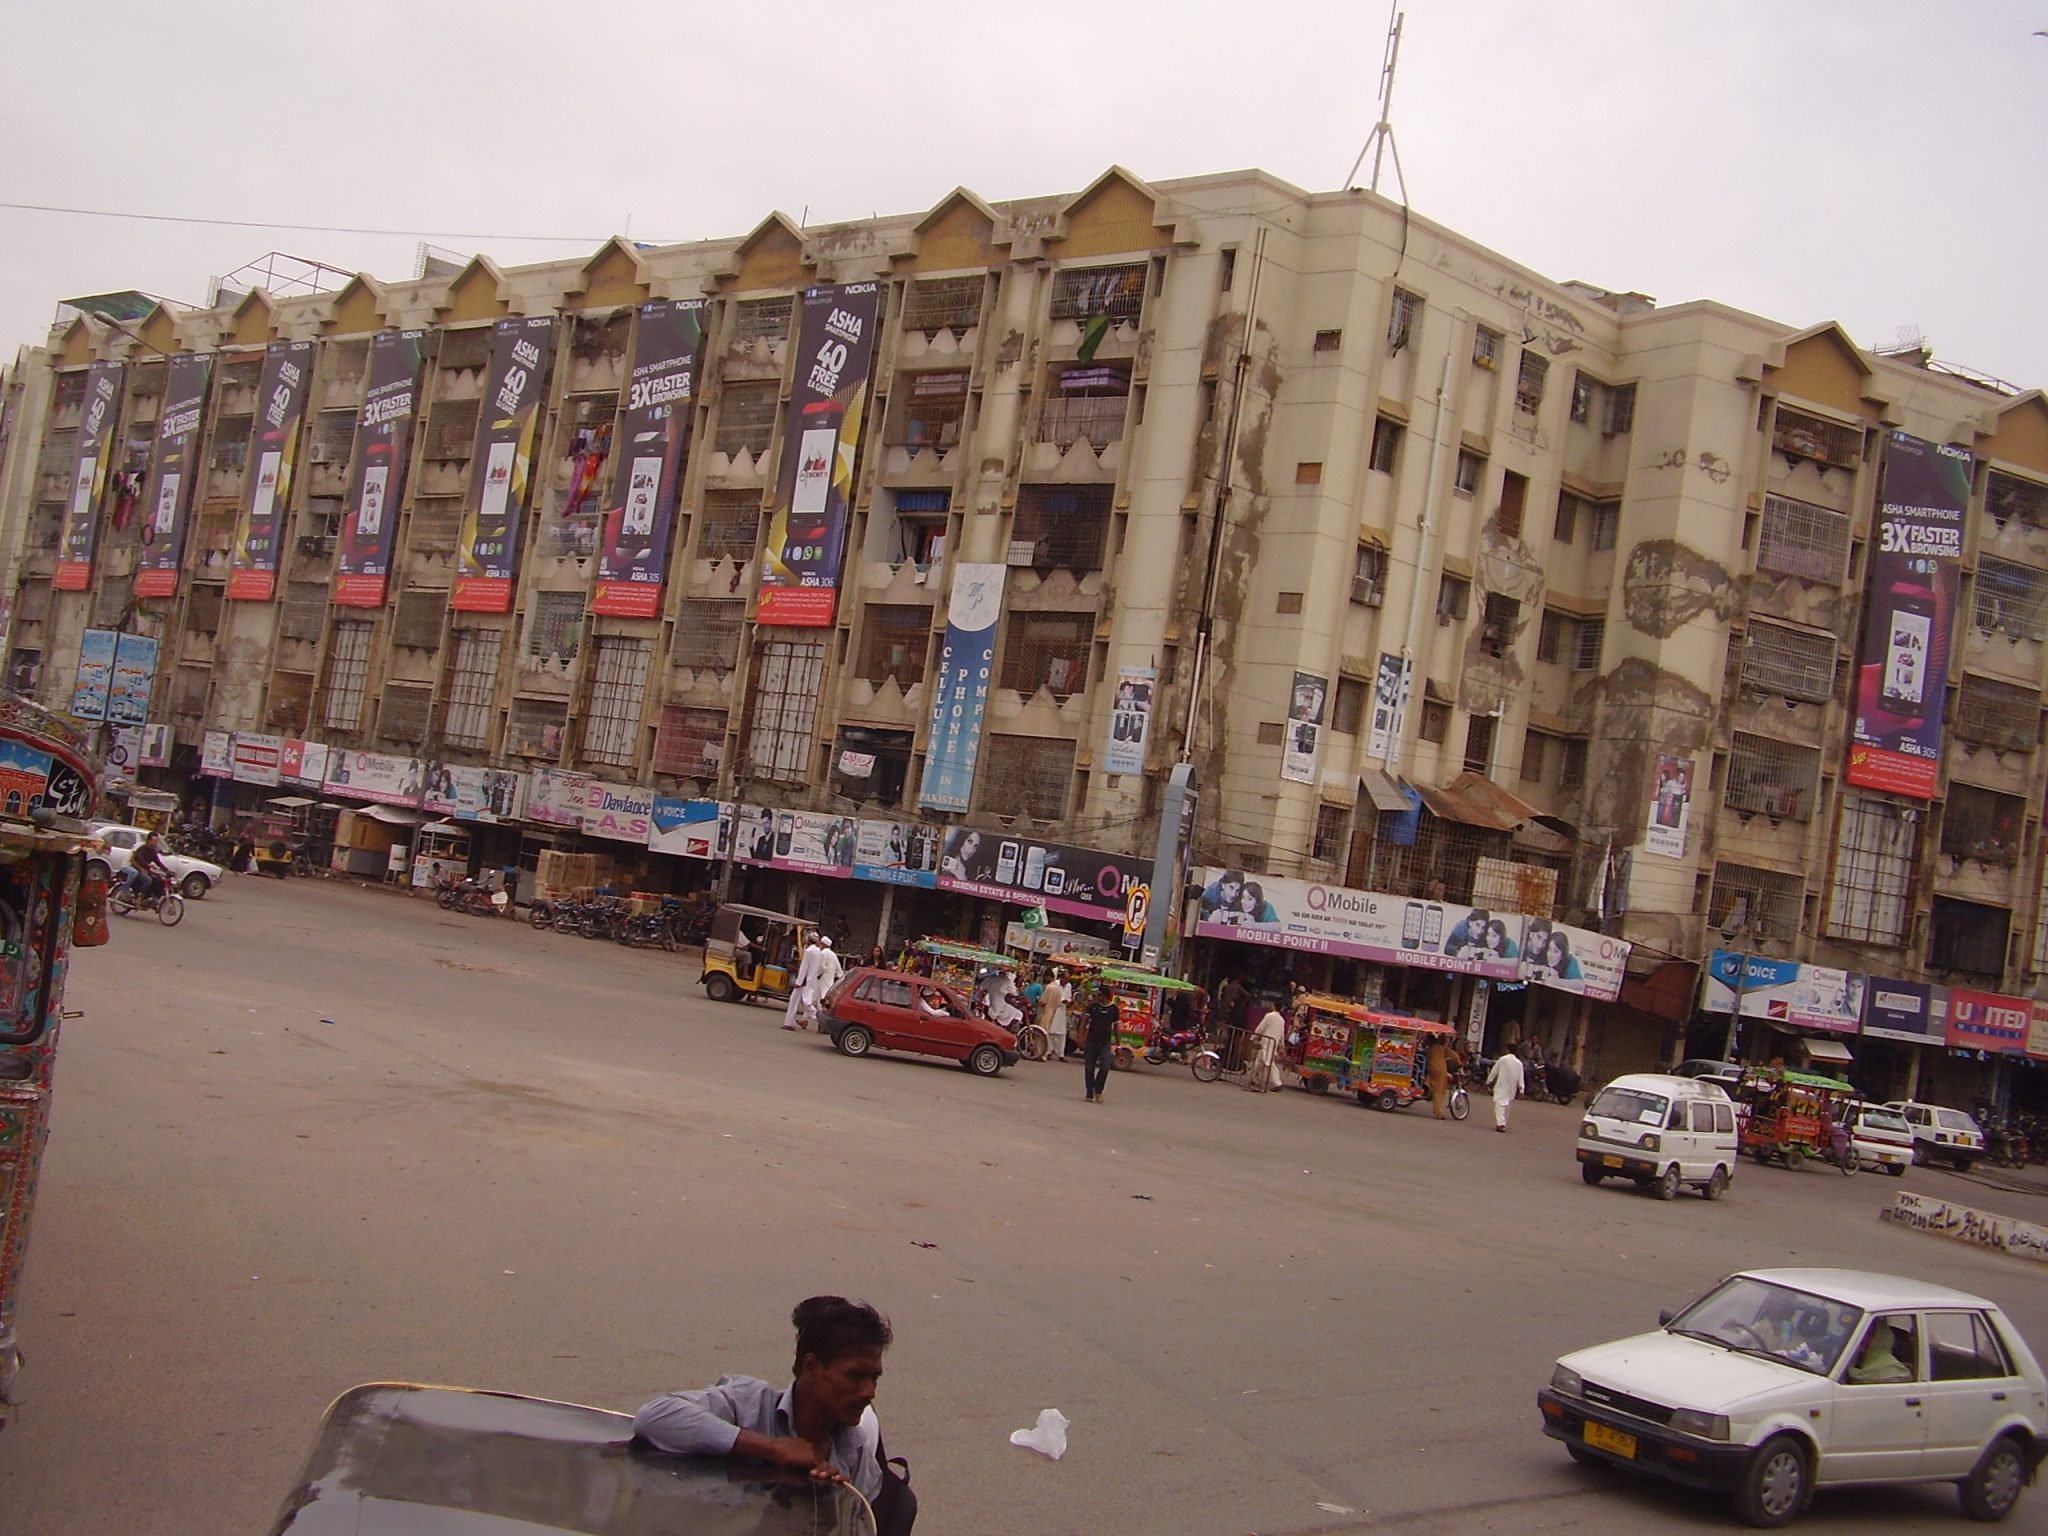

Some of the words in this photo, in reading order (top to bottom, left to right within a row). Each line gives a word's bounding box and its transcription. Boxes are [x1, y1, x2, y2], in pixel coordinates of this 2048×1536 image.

[845, 283, 877, 295] NOKIA
[676, 301, 703, 310] NOKIA
[527, 319, 550, 328] NOKIA
[827, 307, 863, 337] ASHA
[401, 331, 423, 339] NOKIA
[513, 338, 539, 363] ASHA
[816, 339, 847, 373] 40
[632, 365, 648, 378] ASHA
[648, 354, 692, 373] SMARTPHONE
[504, 365, 527, 395] 40
[651, 372, 690, 393] FASTER
[810, 364, 839, 389] FREE
[273, 384, 291, 410] 40
[381, 392, 412, 412] FASTER
[498, 386, 520, 409] FREE
[629, 381, 653, 410] 3X
[363, 401, 383, 427] 3X
[1936, 444, 1971, 462] NOKIA
[1881, 503, 1904, 515] ASHA
[1904, 505, 1961, 521] SMARTPHONE
[1880, 522, 1911, 554] 3X
[1911, 526, 1960, 545] FASTER
[1911, 542, 1961, 558] BROWSING
[800, 577, 820, 587] ASHA
[1899, 743, 1921, 755] ASHA
[602, 792, 651, 816] Dawlance
[919, 791, 968, 807] PAKISTAN
[663, 806, 686, 819] VOICE
[979, 885, 1005, 897] ESTATE
[1011, 891, 1047, 905] SERVICES
[1307, 885, 1377, 914] QMobile
[1236, 928, 1281, 944] MOBILE
[1283, 934, 1318, 950] POINT
[1395, 951, 1437, 965] MOBILE
[1438, 956, 1473, 970] POINT
[1746, 964, 1777, 980] OICE
[1956, 1001, 2026, 1029] UITED
[1957, 1023, 2020, 1039] MOBILE
